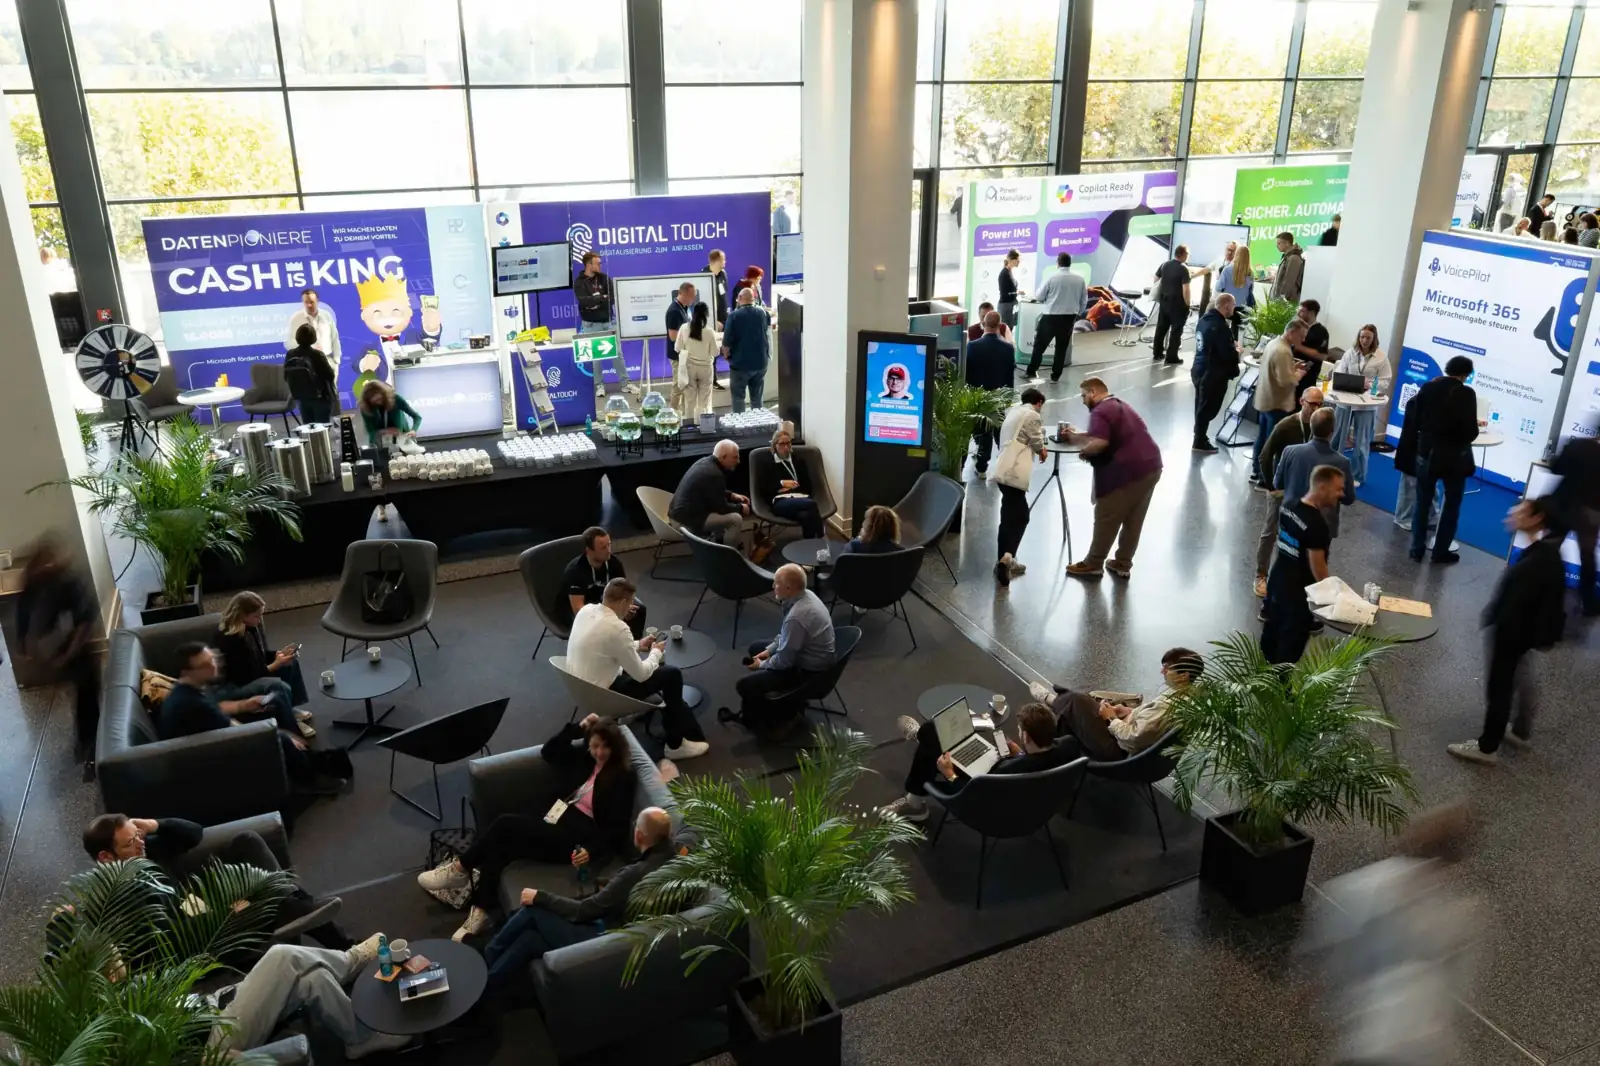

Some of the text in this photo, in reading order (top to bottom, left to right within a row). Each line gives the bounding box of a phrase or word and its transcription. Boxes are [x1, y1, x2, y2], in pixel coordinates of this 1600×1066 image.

[1078, 182, 1134, 194] Copilot Ready
[1244, 201, 1344, 220] SICHER. AUTOMA
[161, 230, 313, 250] DATENPIONIERE
[598, 221, 727, 245] DIGITAL TOUCH
[982, 228, 1031, 240] Power IMS
[600, 246, 652, 256] DIGITALISIERUNG
[168, 256, 404, 295] CASH IS KING
[1444, 264, 1491, 283] VoicePilot
[1426, 289, 1520, 320] Microsoft 365
[1436, 307, 1487, 325] Spracheingabe
[1488, 321, 1518, 332] steuern
[548, 390, 577, 398] ALTOUCH
